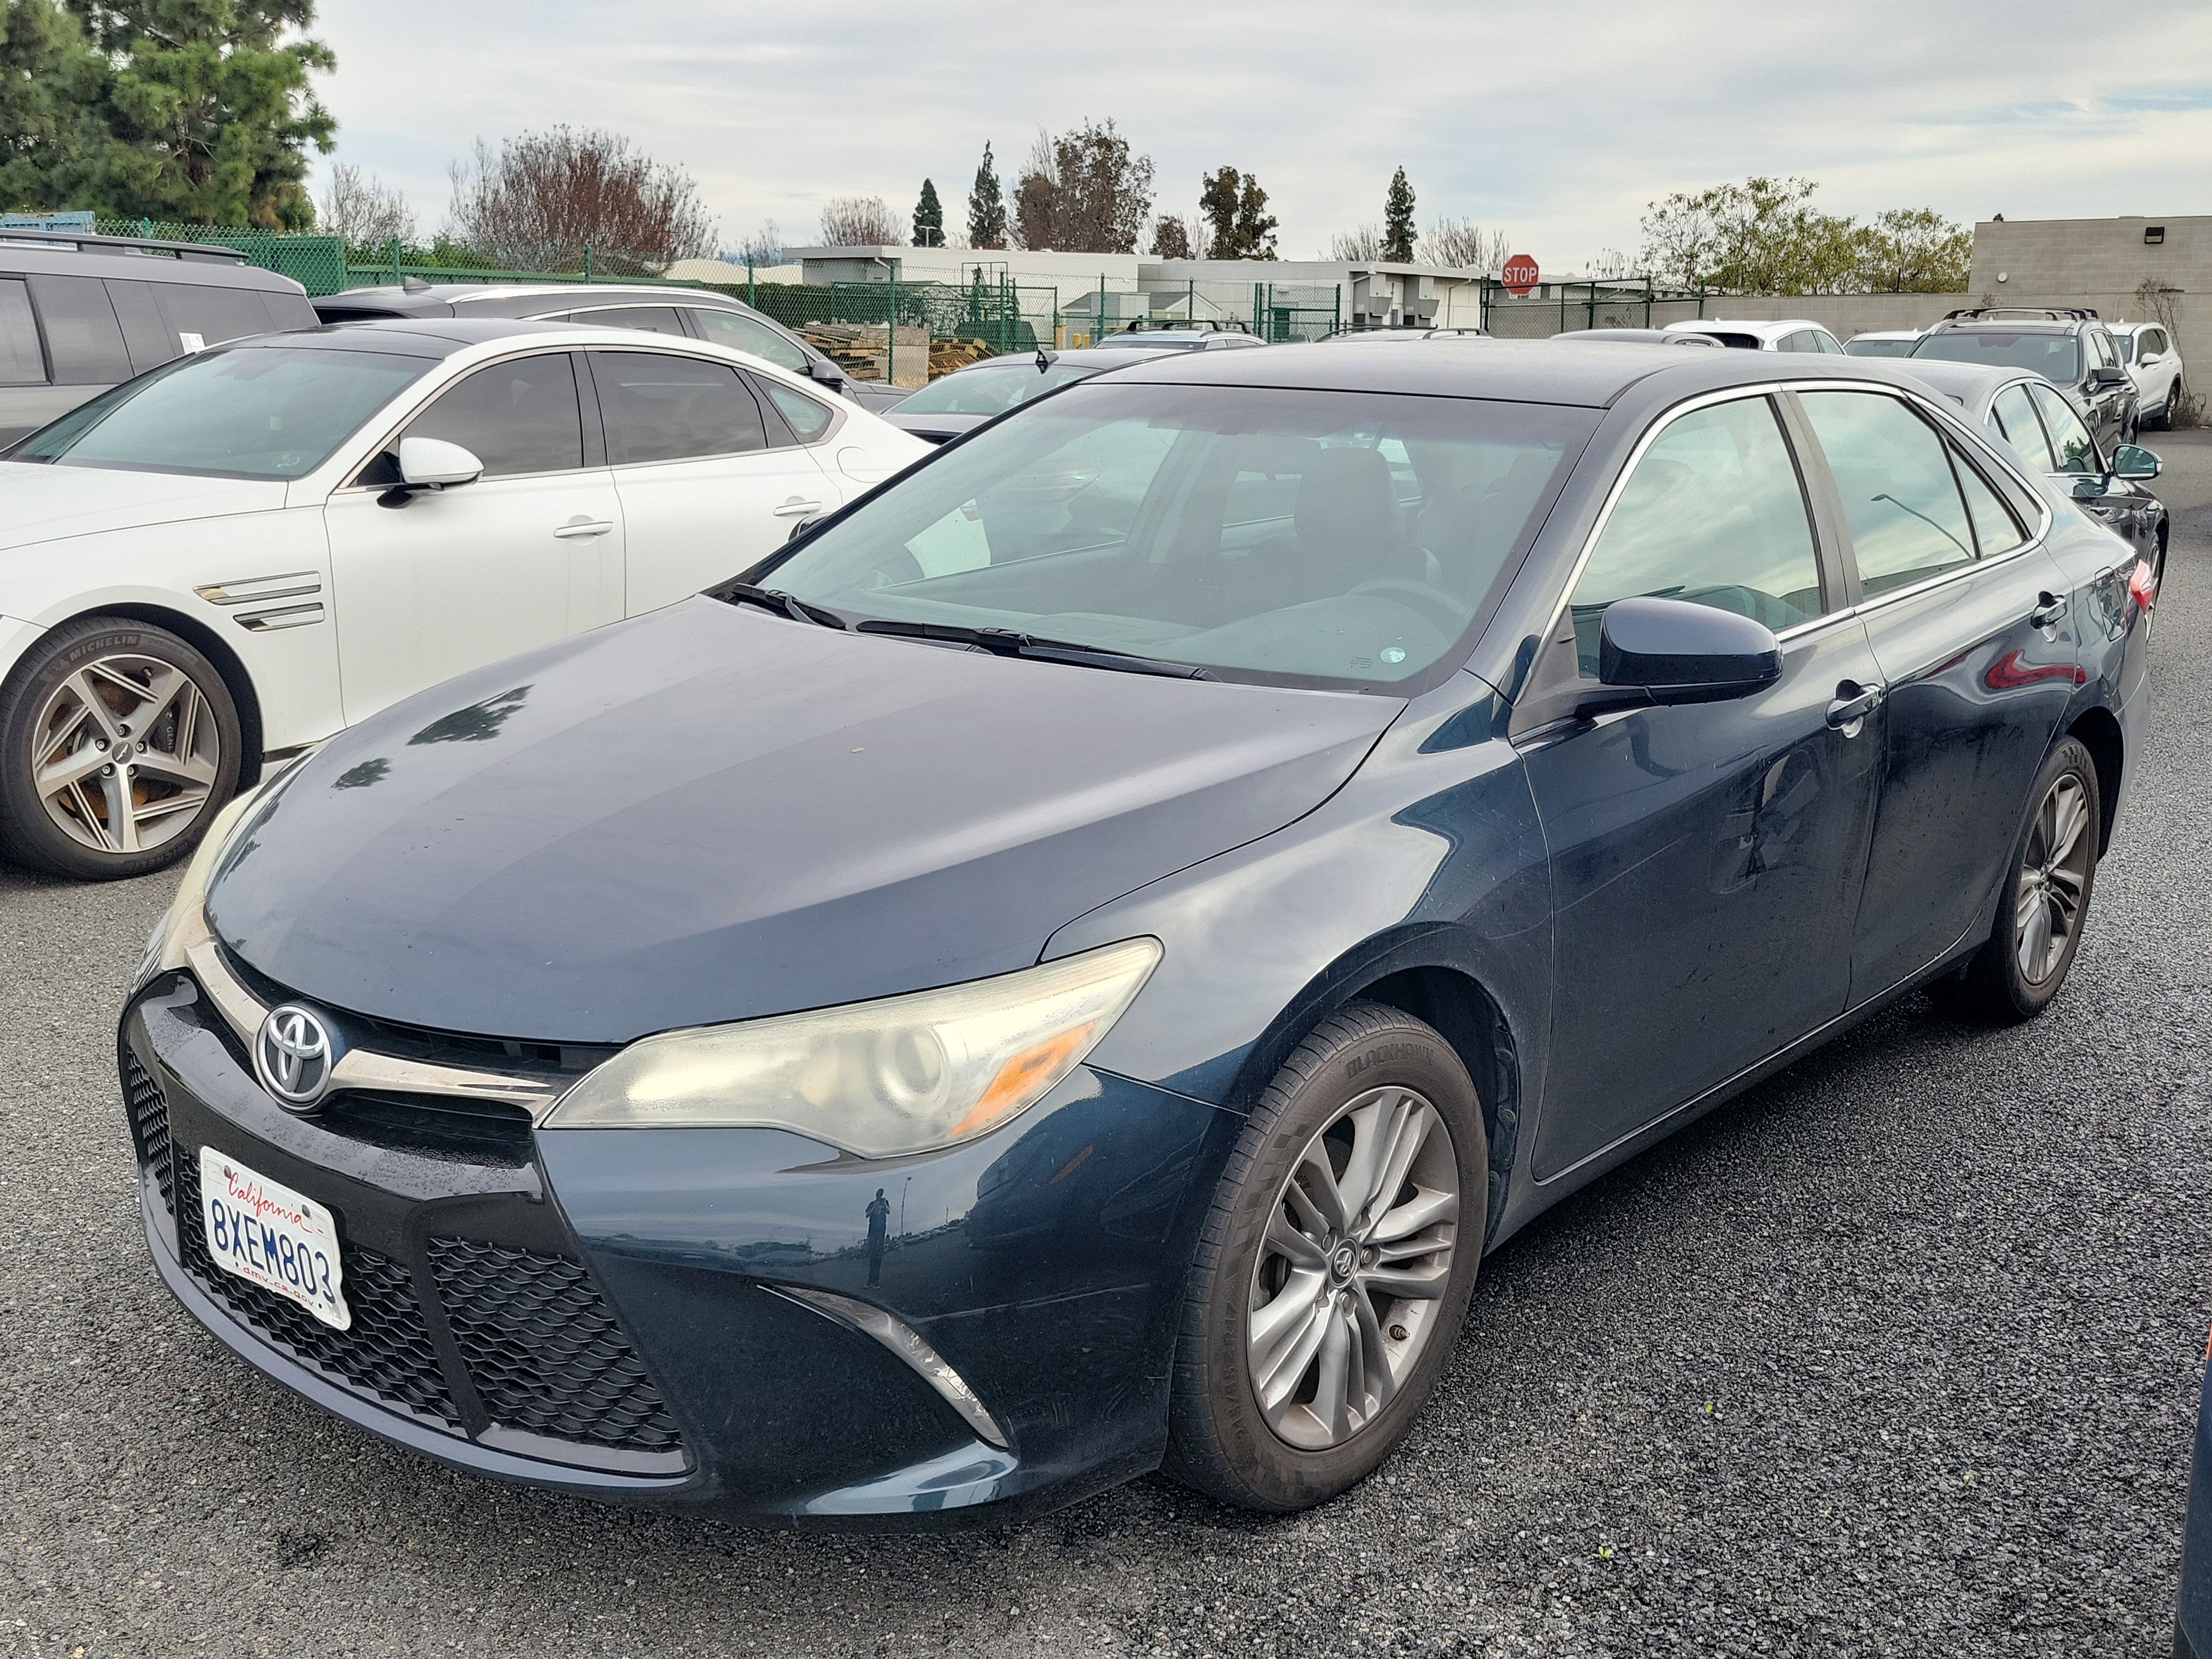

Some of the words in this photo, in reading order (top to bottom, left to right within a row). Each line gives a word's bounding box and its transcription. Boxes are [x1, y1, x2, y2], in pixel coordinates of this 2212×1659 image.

[1504, 267, 1537, 283] STOP
[69, 635, 138, 662] MICHELIN
[229, 1172, 313, 1234] California
[211, 1198, 336, 1304] 8XEM803
